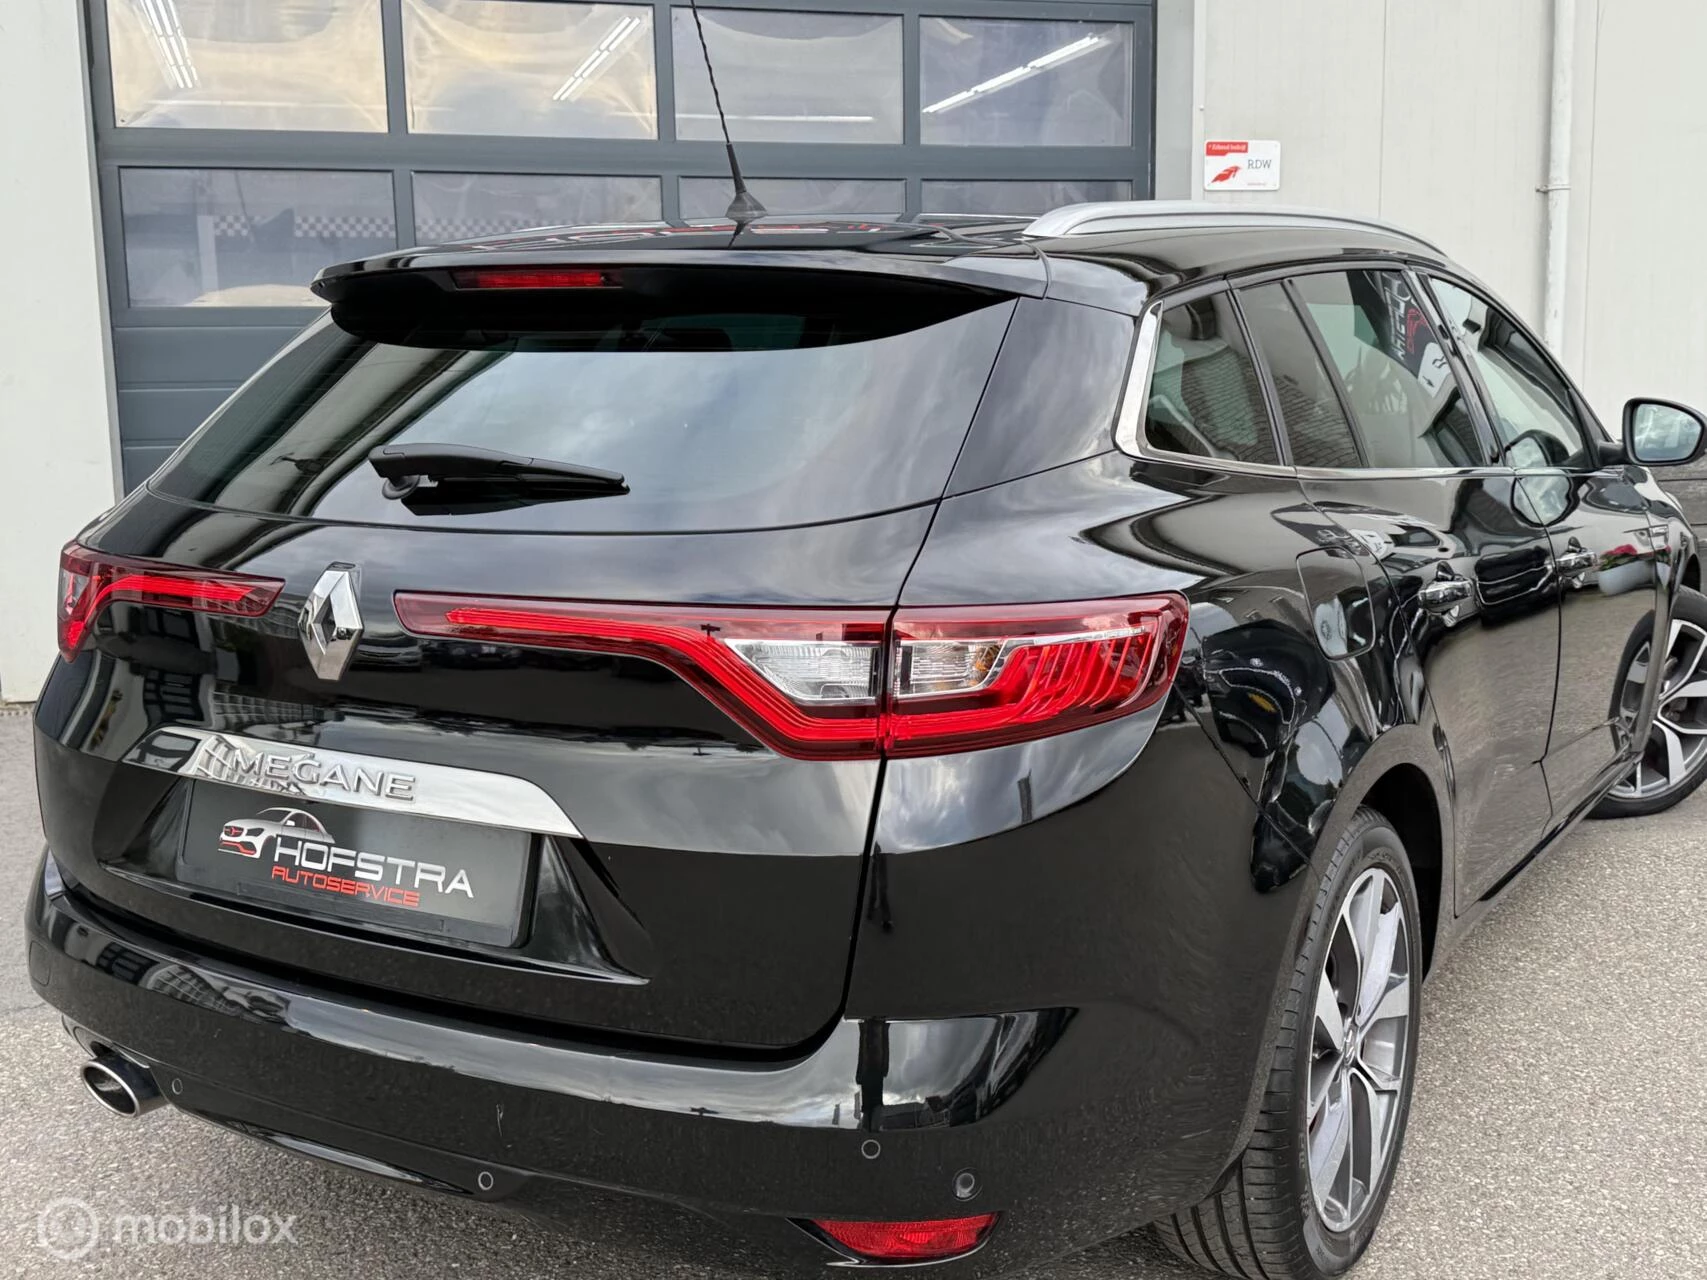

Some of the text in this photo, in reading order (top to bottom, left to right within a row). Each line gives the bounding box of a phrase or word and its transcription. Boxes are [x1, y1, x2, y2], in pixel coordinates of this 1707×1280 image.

[1247, 159, 1272, 169] RDW
[271, 865, 420, 907] AUTOSERVICE
[274, 834, 474, 898] HOFSTRA
